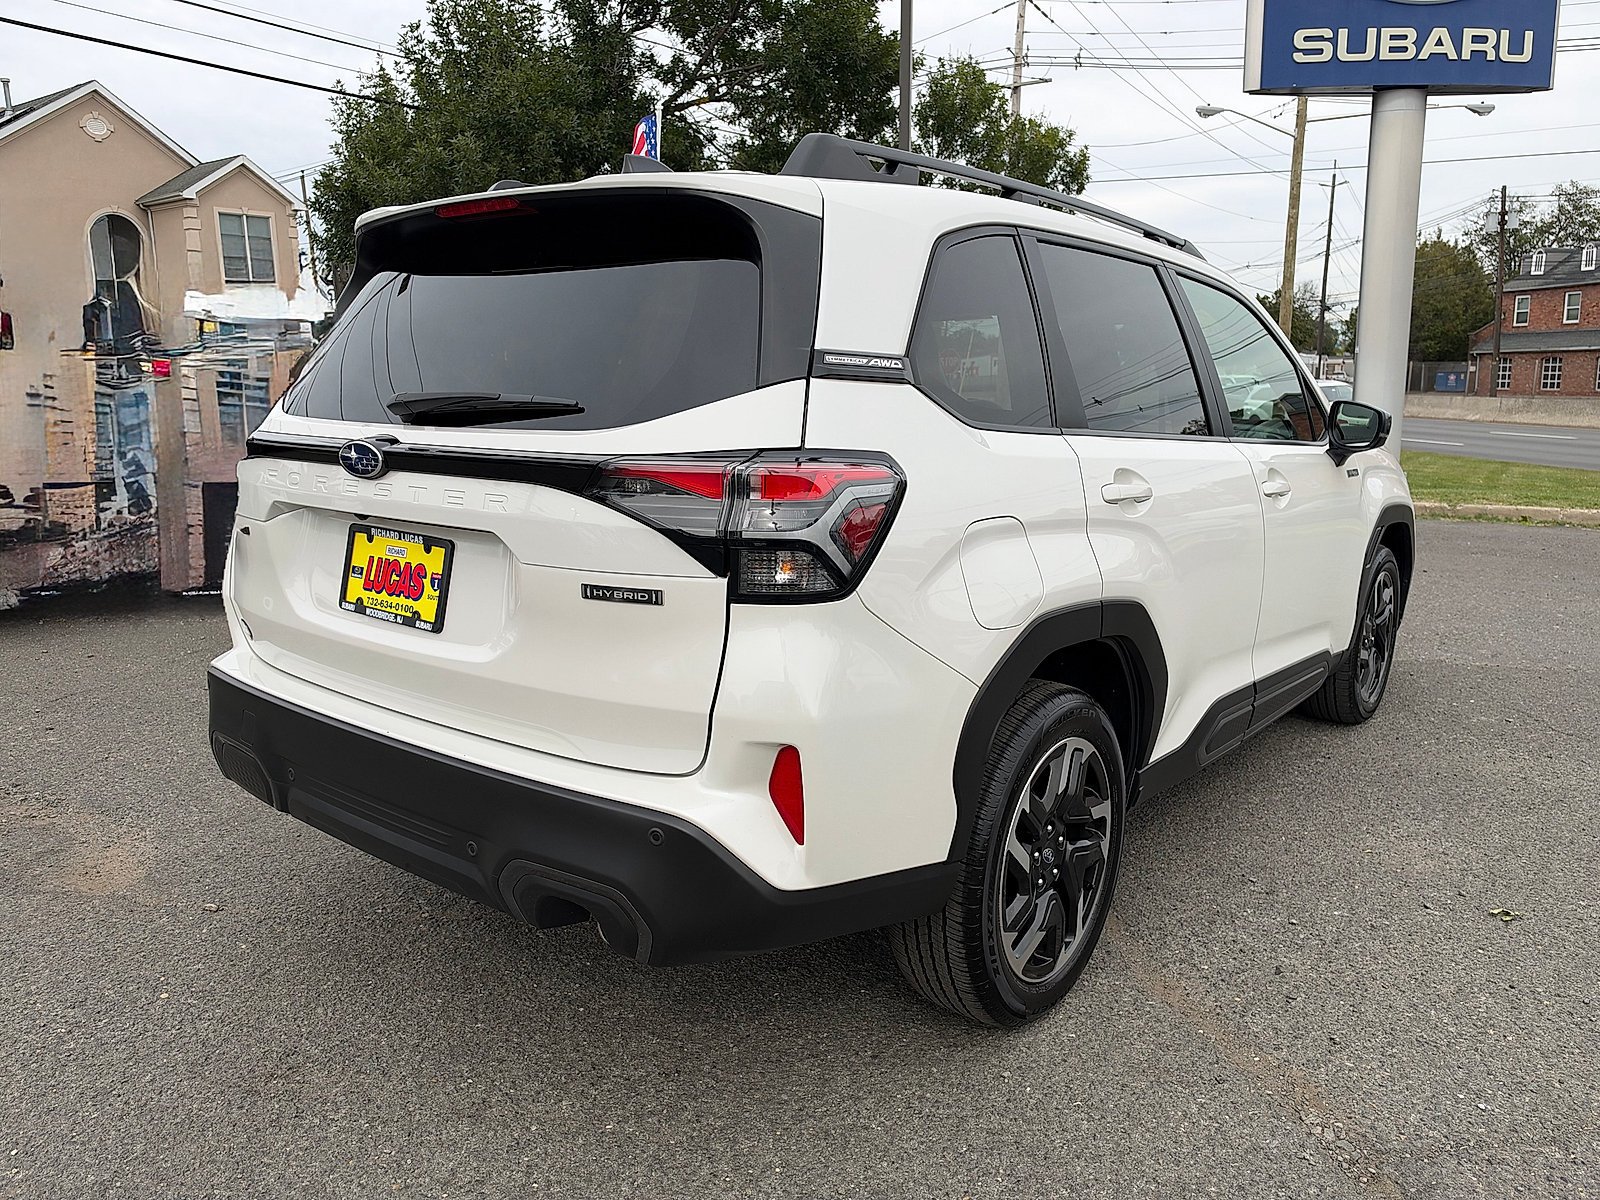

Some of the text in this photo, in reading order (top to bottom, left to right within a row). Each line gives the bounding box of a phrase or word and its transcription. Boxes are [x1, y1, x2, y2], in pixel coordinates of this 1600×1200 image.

[1292, 27, 1534, 63] SUBARU
[868, 359, 903, 368] AWD
[264, 469, 508, 512] FORESTER
[371, 527, 424, 544] RICHARD LUCAS
[387, 546, 406, 557] RICHARD
[363, 556, 427, 601] LUCAS
[593, 588, 649, 601] HYBRID
[366, 597, 414, 614] 732-634-0100
[396, 615, 404, 624] NJ
[415, 620, 433, 631] SUBARU
